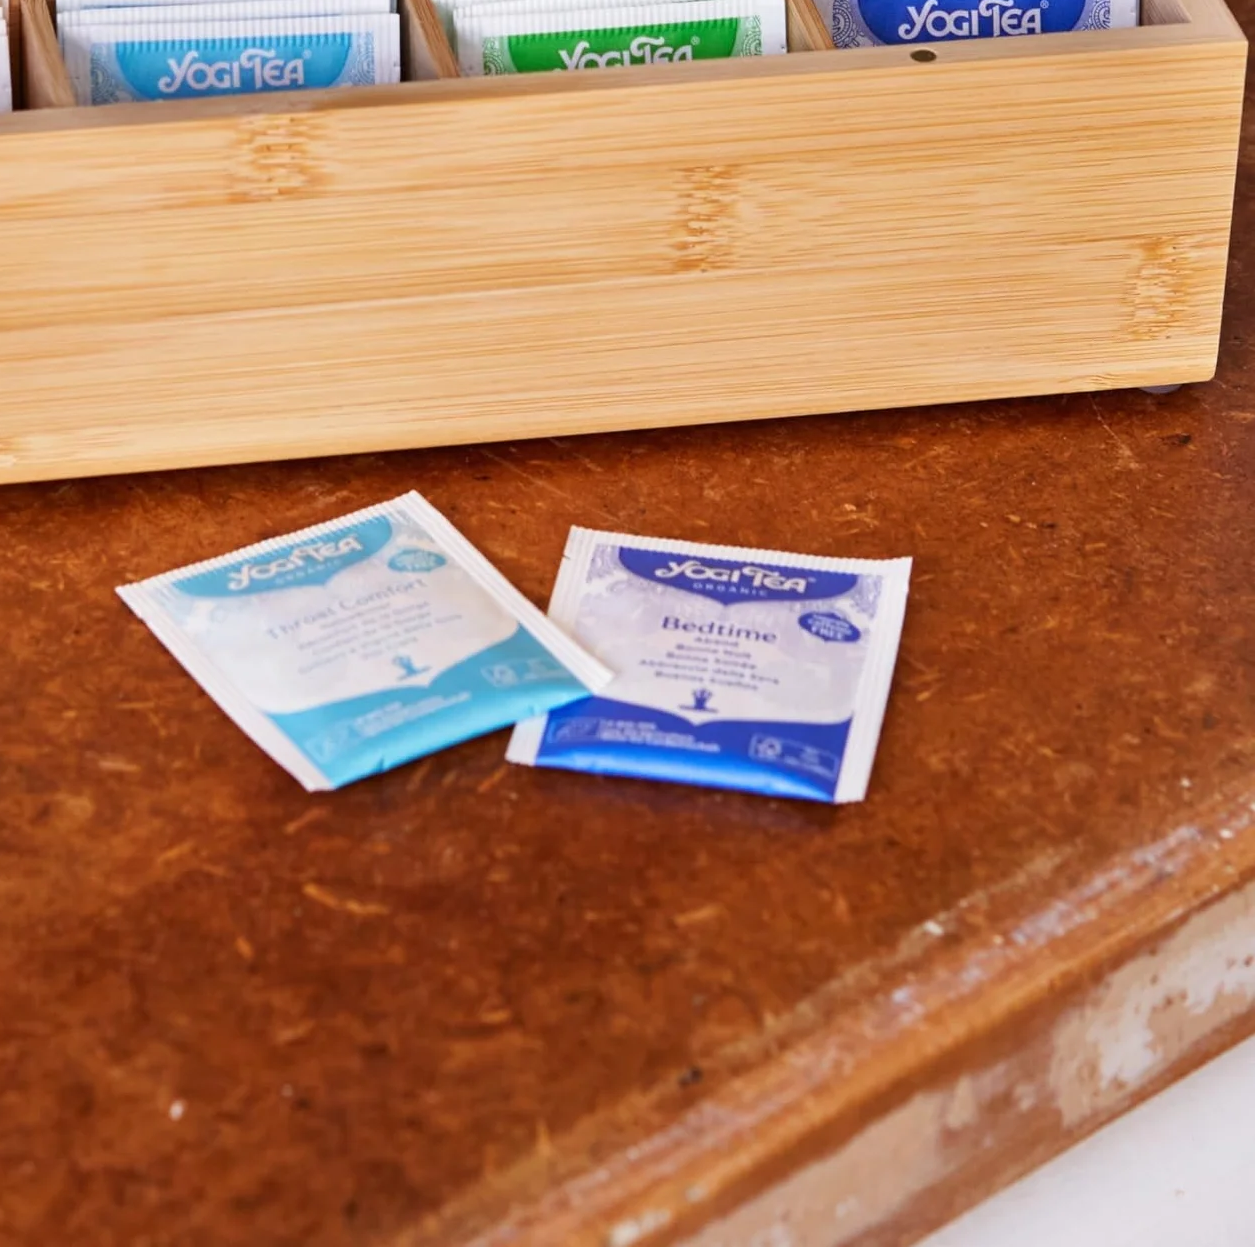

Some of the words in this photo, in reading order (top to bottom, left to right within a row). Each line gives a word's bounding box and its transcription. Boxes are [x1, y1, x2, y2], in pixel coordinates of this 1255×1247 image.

[158, 50, 241, 94] YOGI
[654, 559, 742, 584] YOGI
[661, 615, 778, 643] Bedtime
